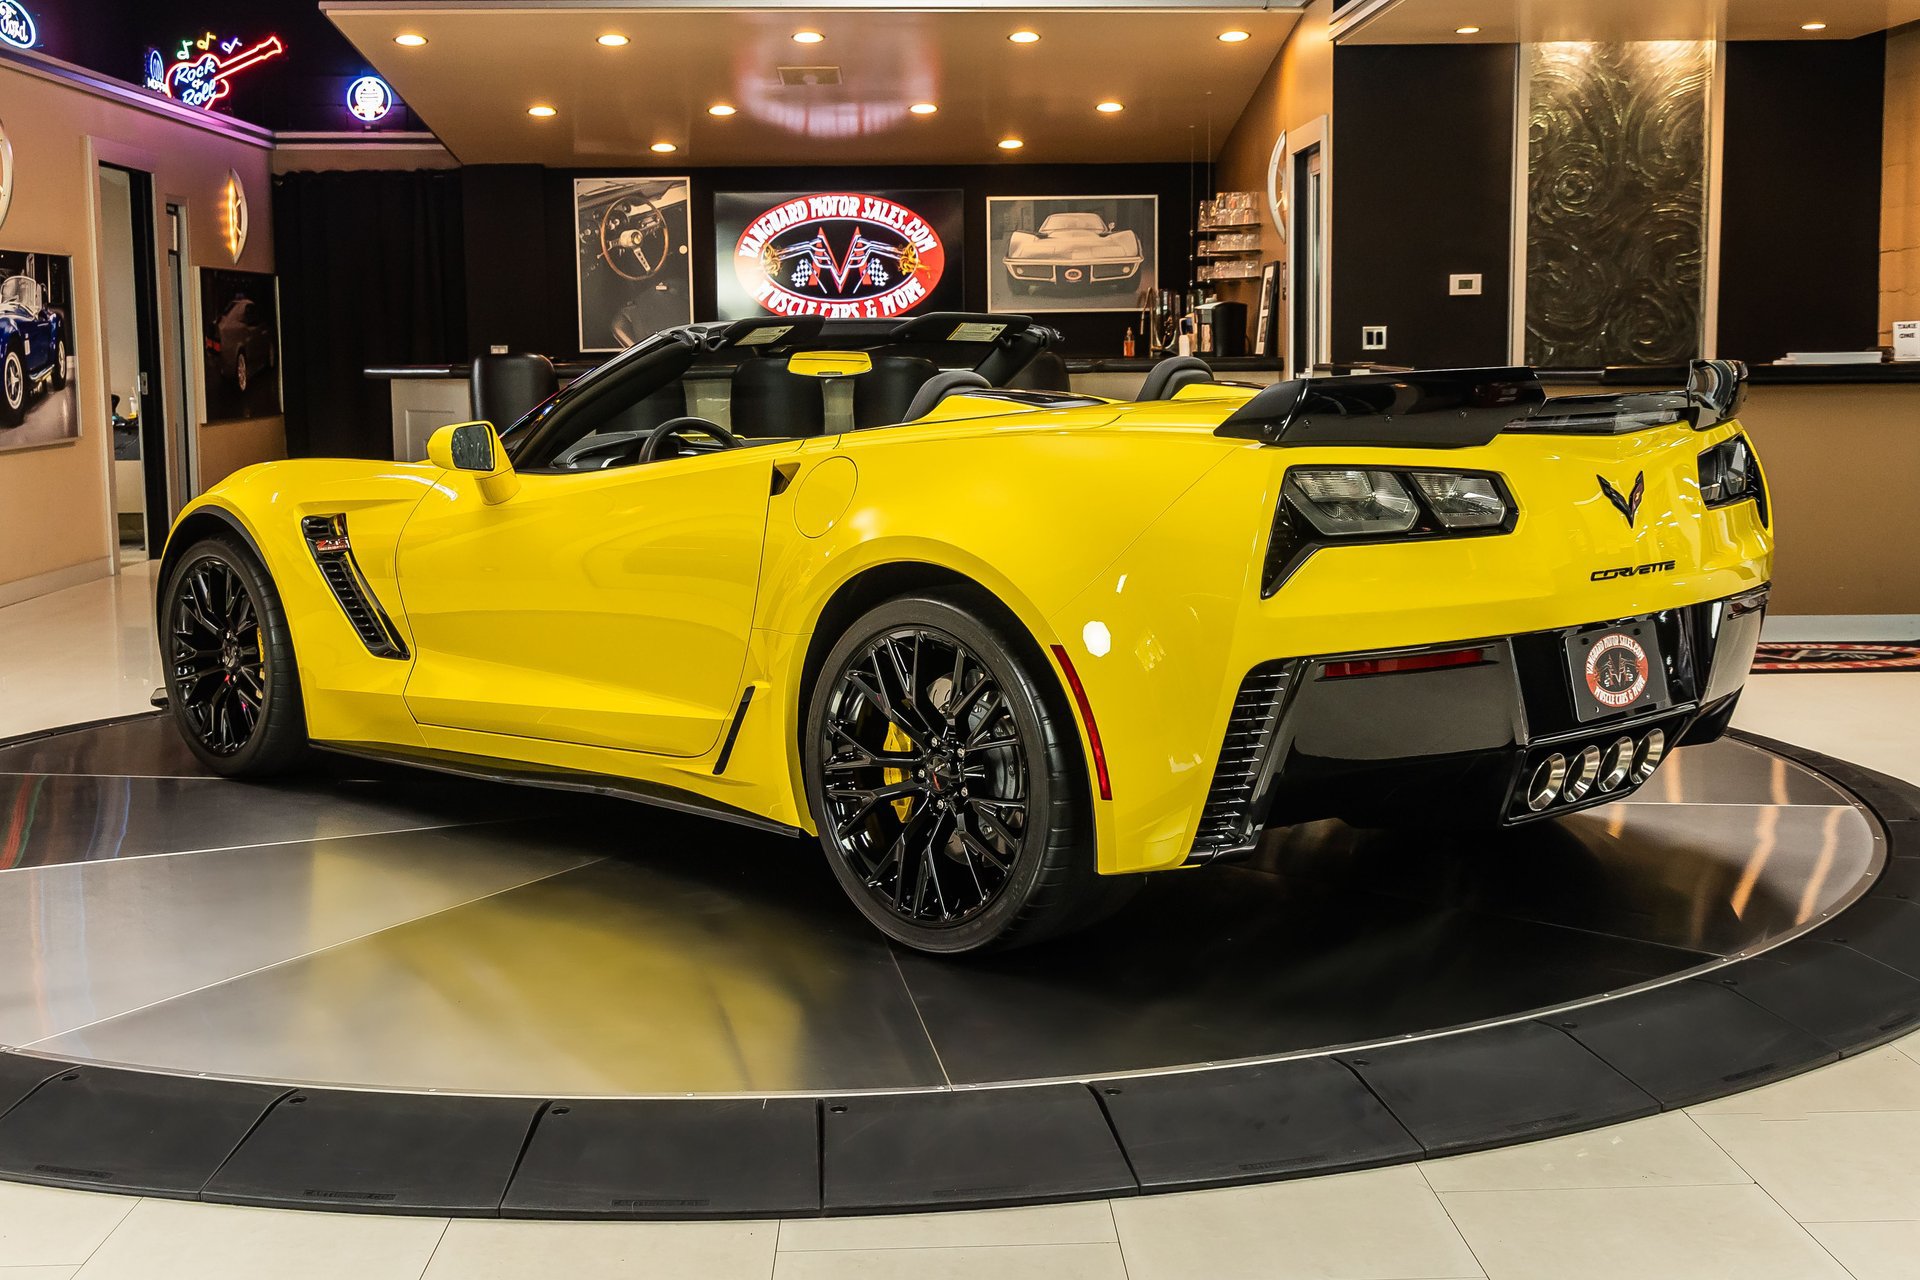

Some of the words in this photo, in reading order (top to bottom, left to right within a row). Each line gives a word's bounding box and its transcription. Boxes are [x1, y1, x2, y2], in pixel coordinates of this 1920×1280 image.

[174, 56, 216, 86] Rock
[182, 78, 217, 106] Roll
[738, 200, 808, 258] VANGUARD
[808, 195, 861, 219] MOTOR
[861, 197, 938, 254] SALES.COM
[753, 279, 818, 316] MUSCLE
[819, 302, 860, 318] CARS
[879, 276, 927, 316] MORE
[1590, 560, 1676, 582] CORVETTE
